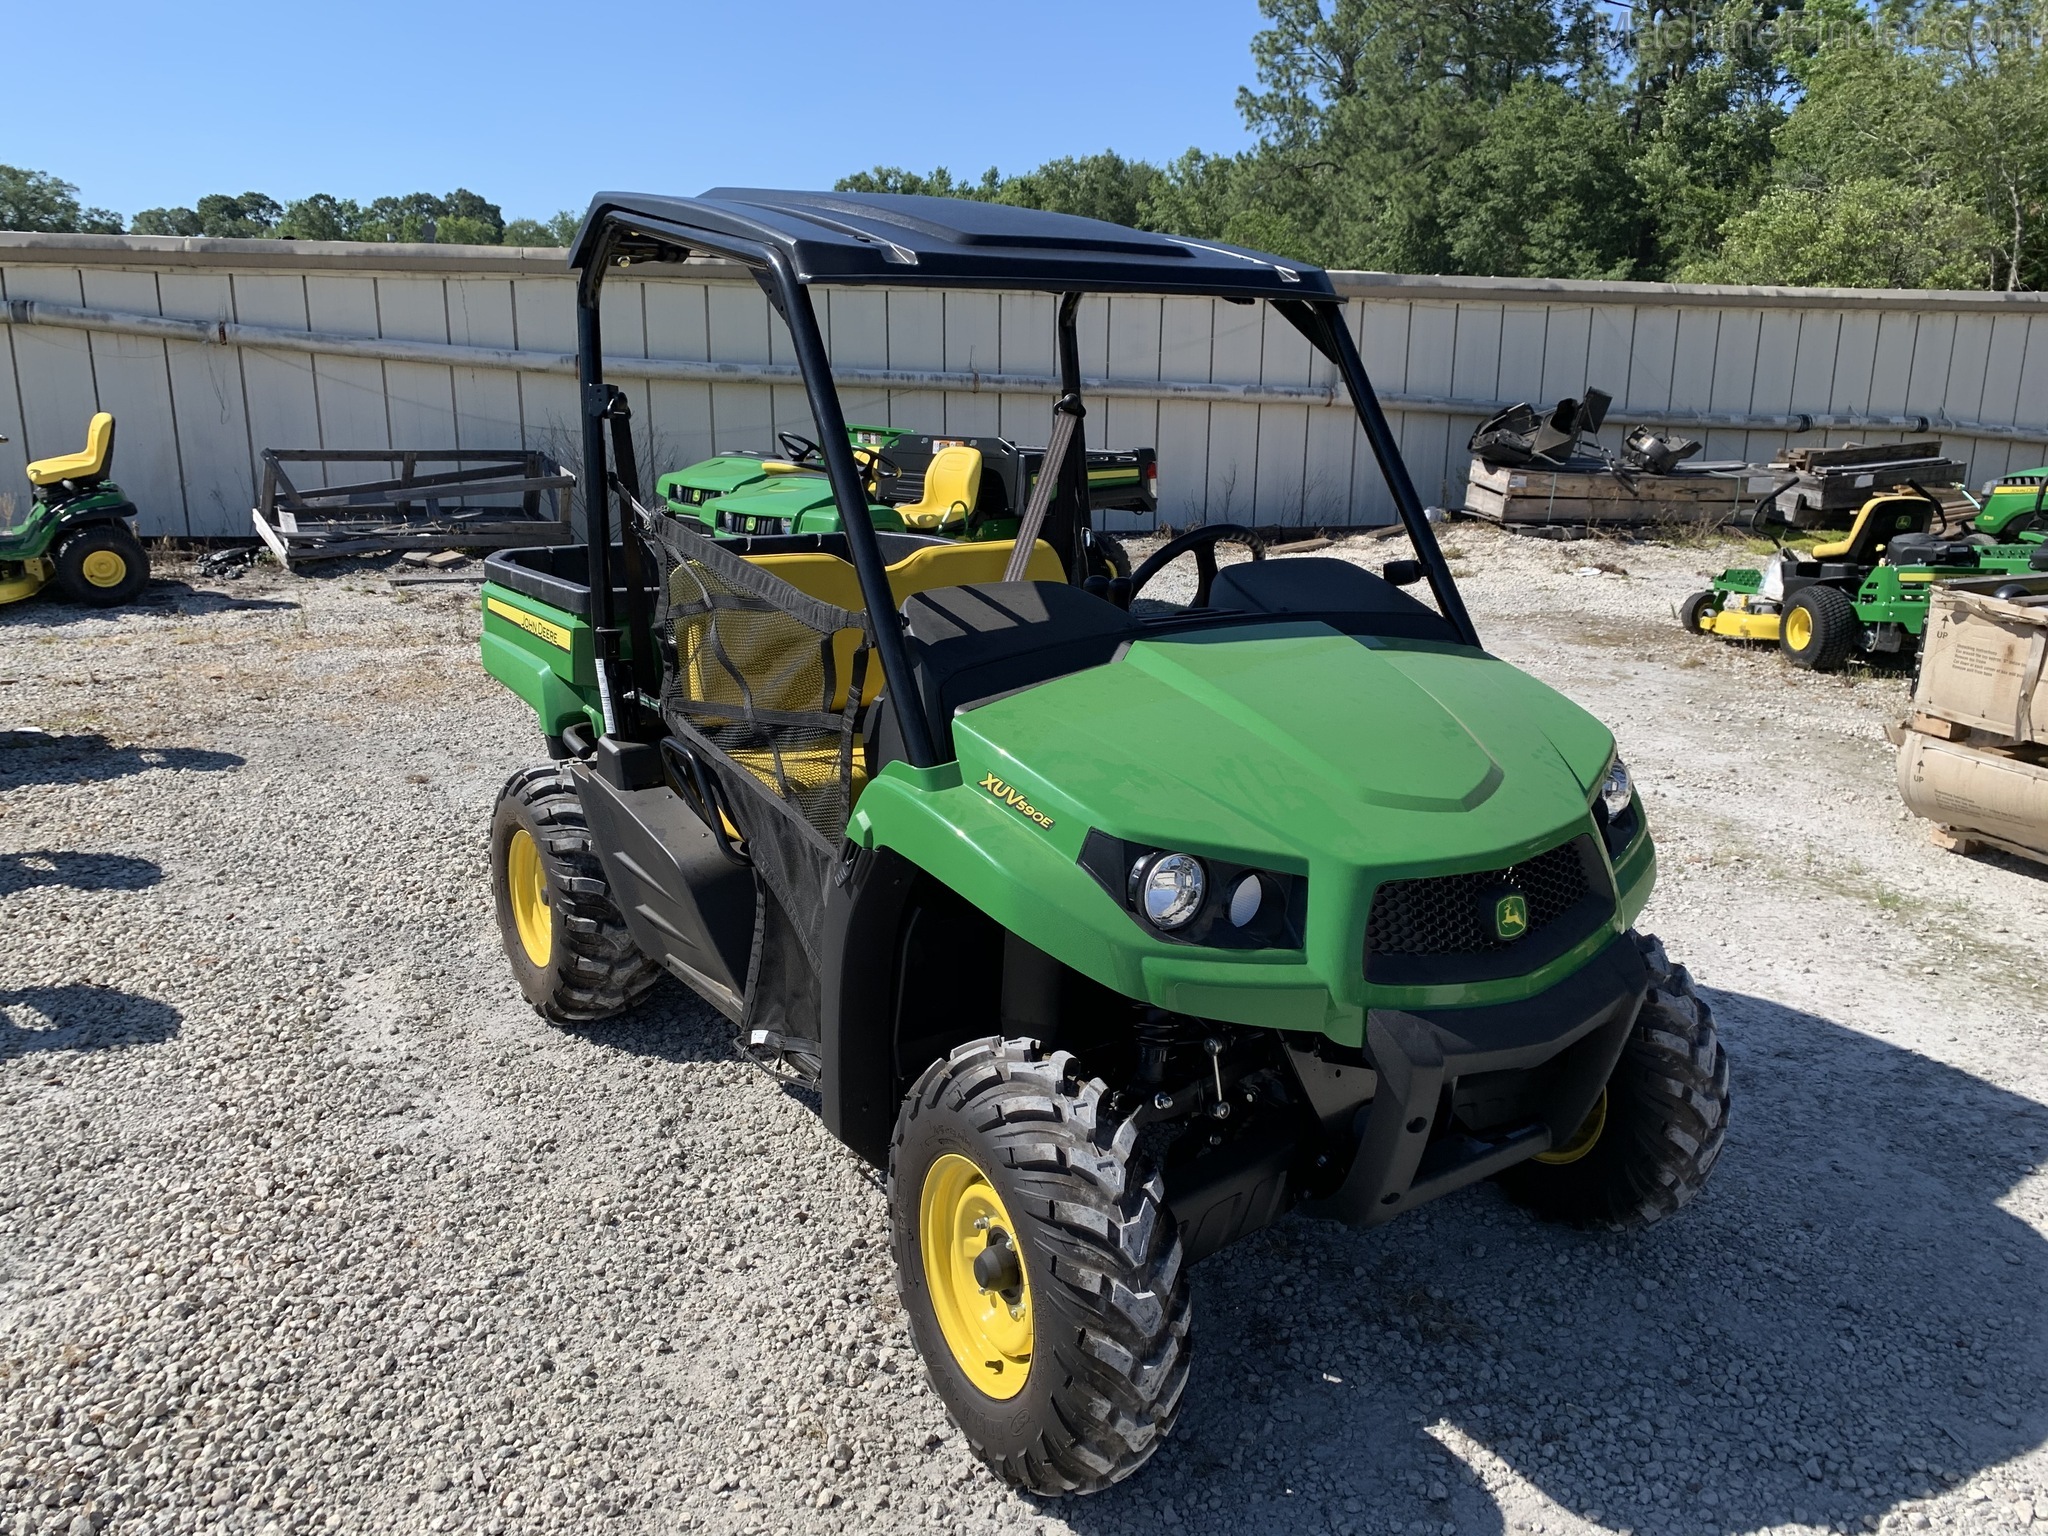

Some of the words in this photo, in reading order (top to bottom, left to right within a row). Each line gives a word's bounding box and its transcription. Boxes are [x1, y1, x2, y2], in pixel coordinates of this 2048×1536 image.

[521, 614, 537, 635] JOHN
[538, 622, 558, 644] DEERE
[1936, 631, 1948, 639] UP
[1913, 774, 1924, 783] UP
[978, 771, 1055, 830] XUV590E
